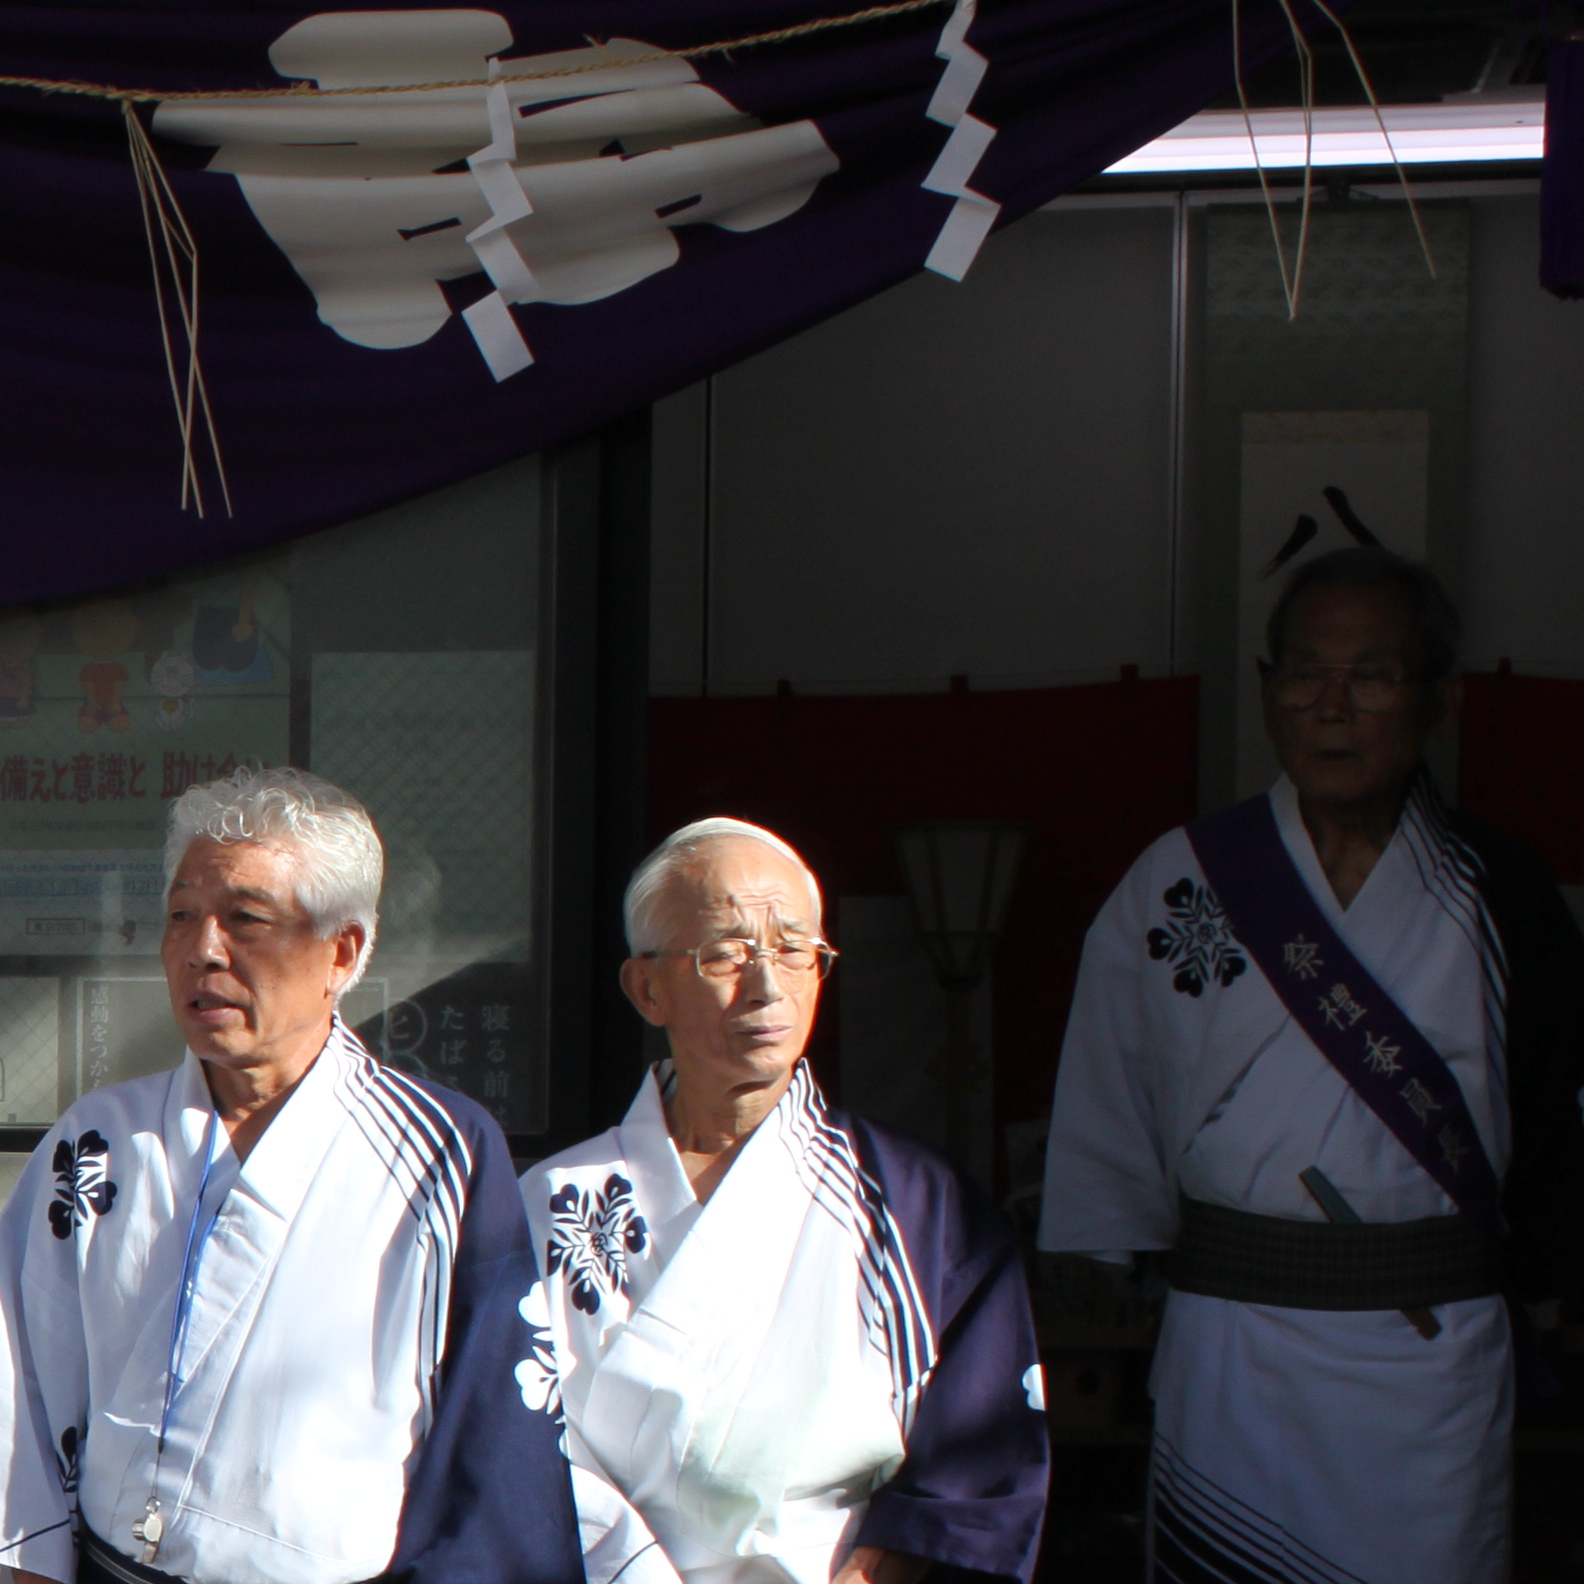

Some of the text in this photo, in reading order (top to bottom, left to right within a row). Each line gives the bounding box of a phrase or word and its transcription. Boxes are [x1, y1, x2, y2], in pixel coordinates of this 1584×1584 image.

[0, 751, 148, 804] 備えと意識と
